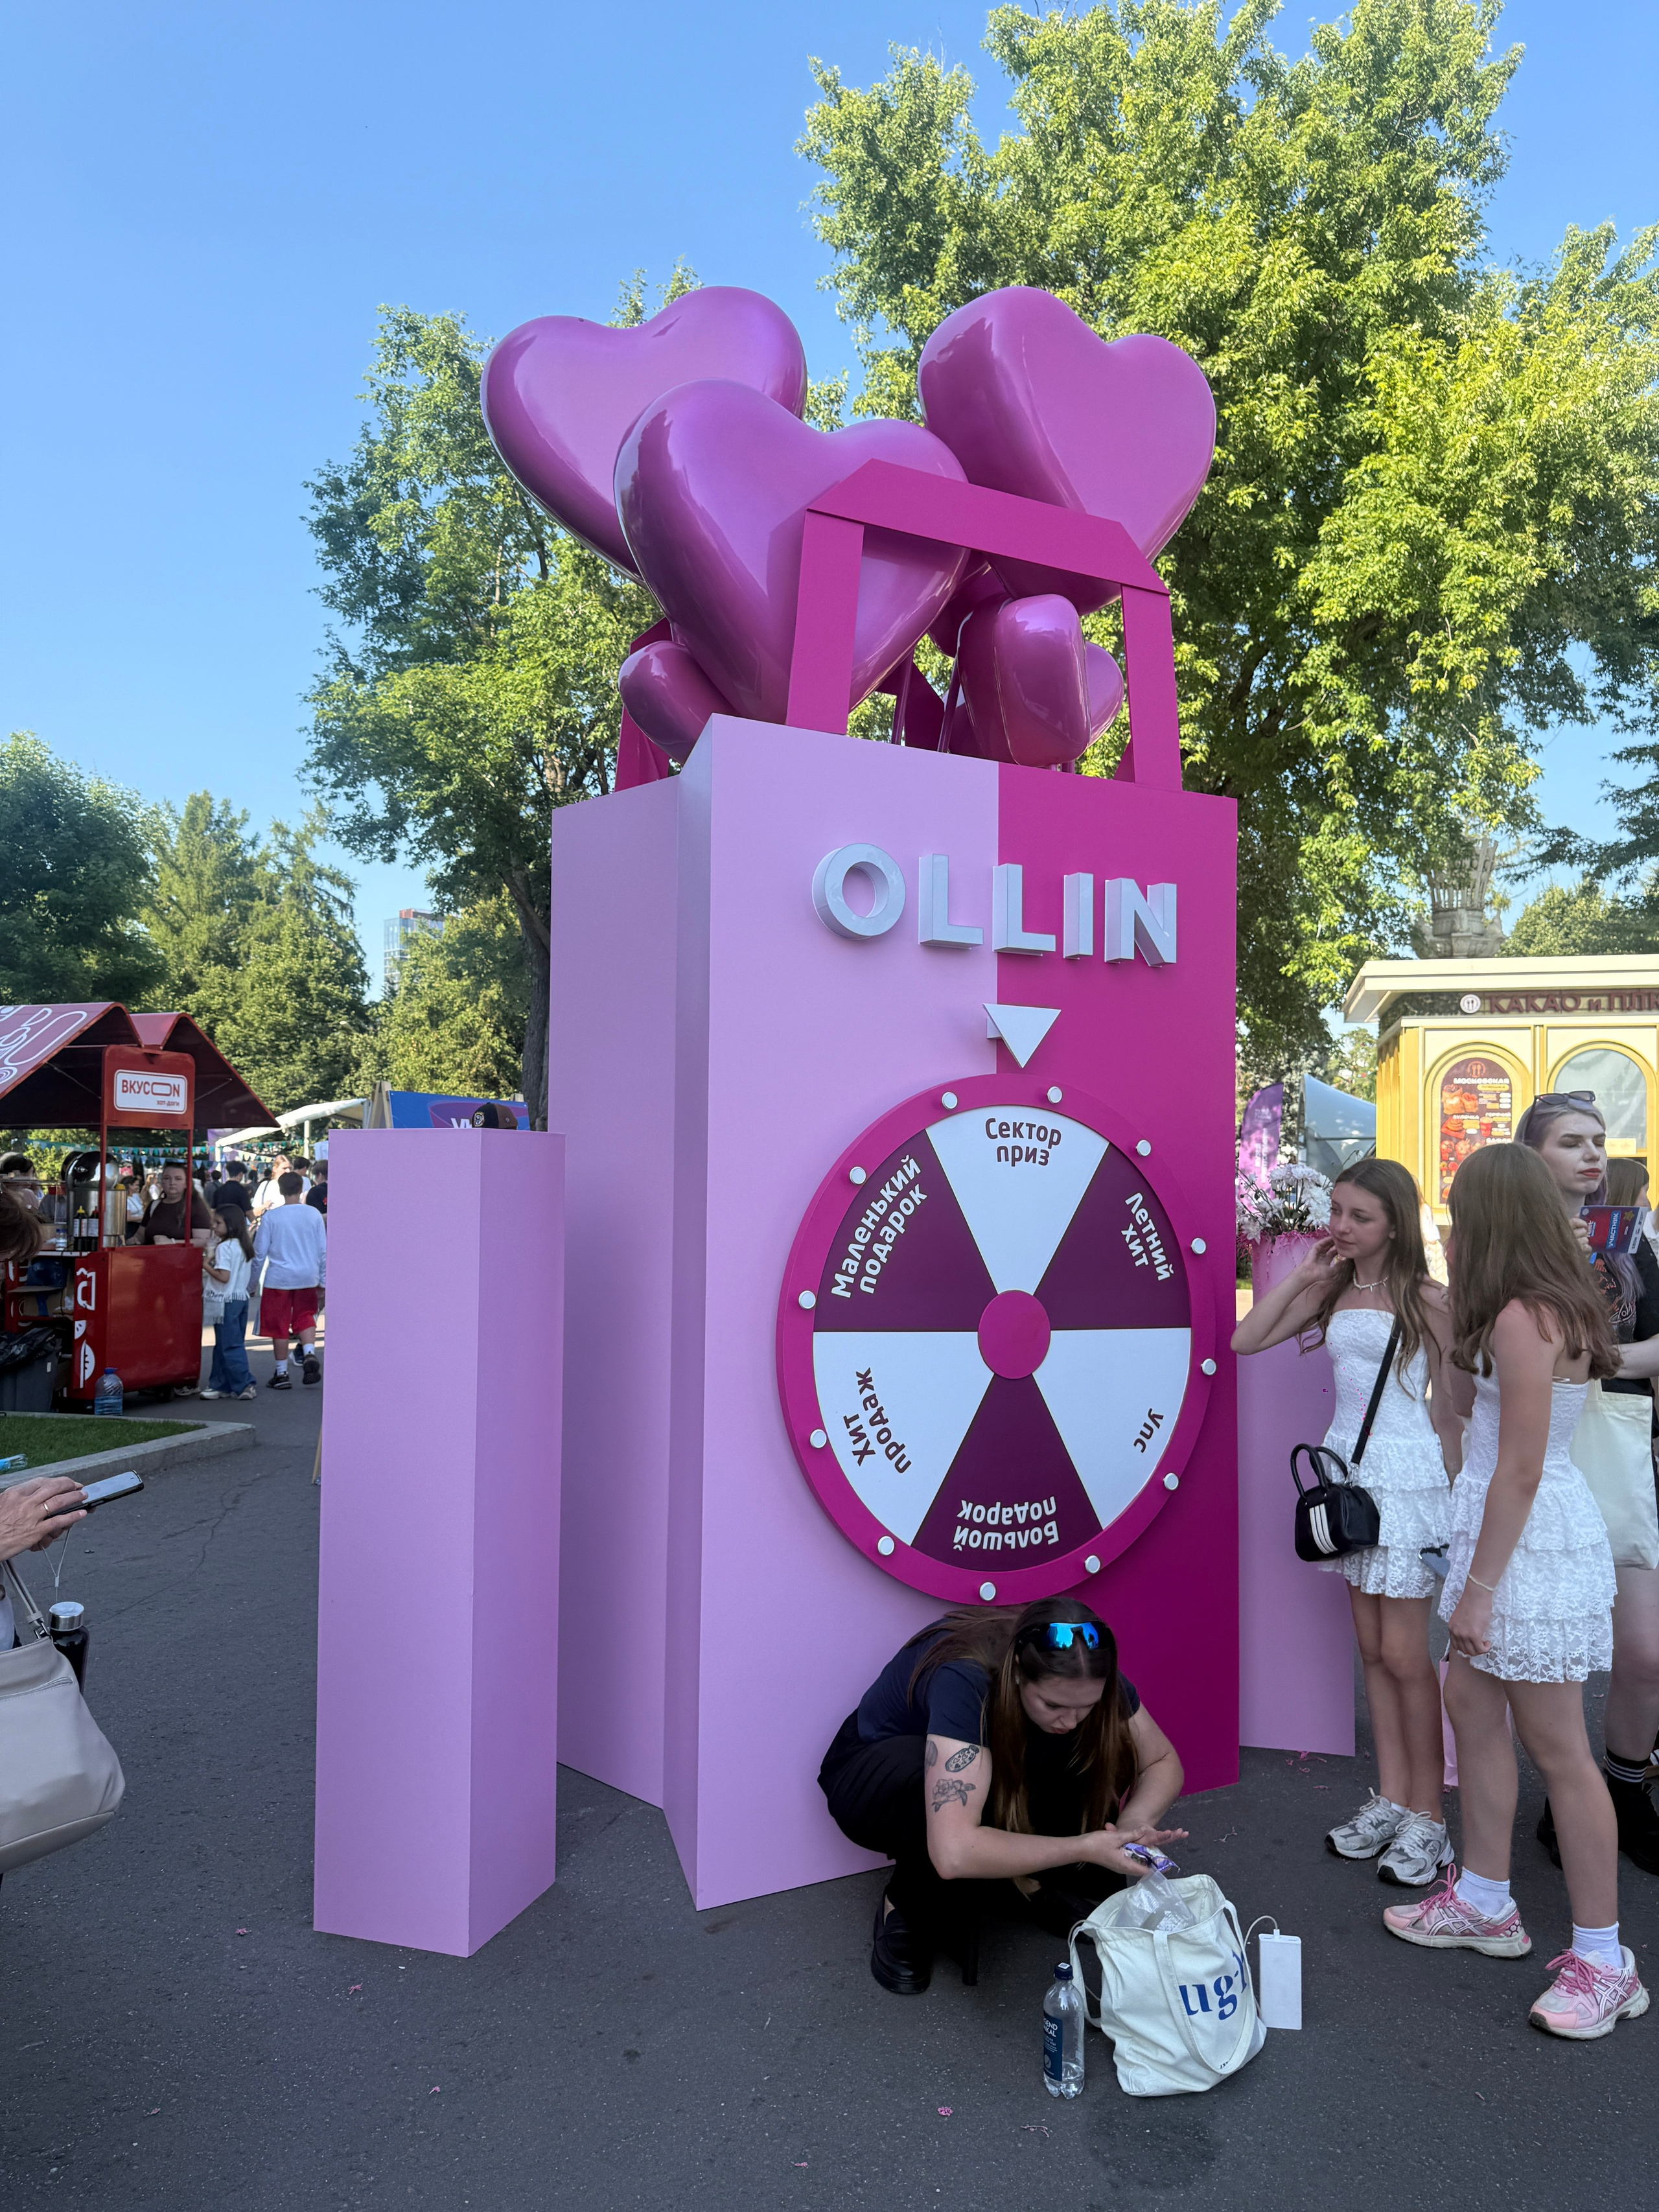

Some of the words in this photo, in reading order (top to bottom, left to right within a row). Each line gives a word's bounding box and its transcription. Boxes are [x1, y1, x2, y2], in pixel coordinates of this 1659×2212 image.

[811, 843, 1178, 967] OLLIN
[1491, 993, 1581, 1013] КАКАО
[1588, 997, 1601, 1012] и
[984, 1117, 1062, 1148] Сектор
[996, 1143, 1050, 1167] приз
[830, 1154, 923, 1298] Маленький
[859, 1183, 927, 1294] подарок
[1120, 1222, 1149, 1268] хит
[1124, 1193, 1174, 1282] Летний
[1608, 1213, 1619, 1248] УЧАСТНИК
[843, 1413, 877, 1467] Хит
[855, 1368, 912, 1474] продаж
[957, 1496, 1057, 1524] подарок
[953, 1520, 1060, 1552] Большой
